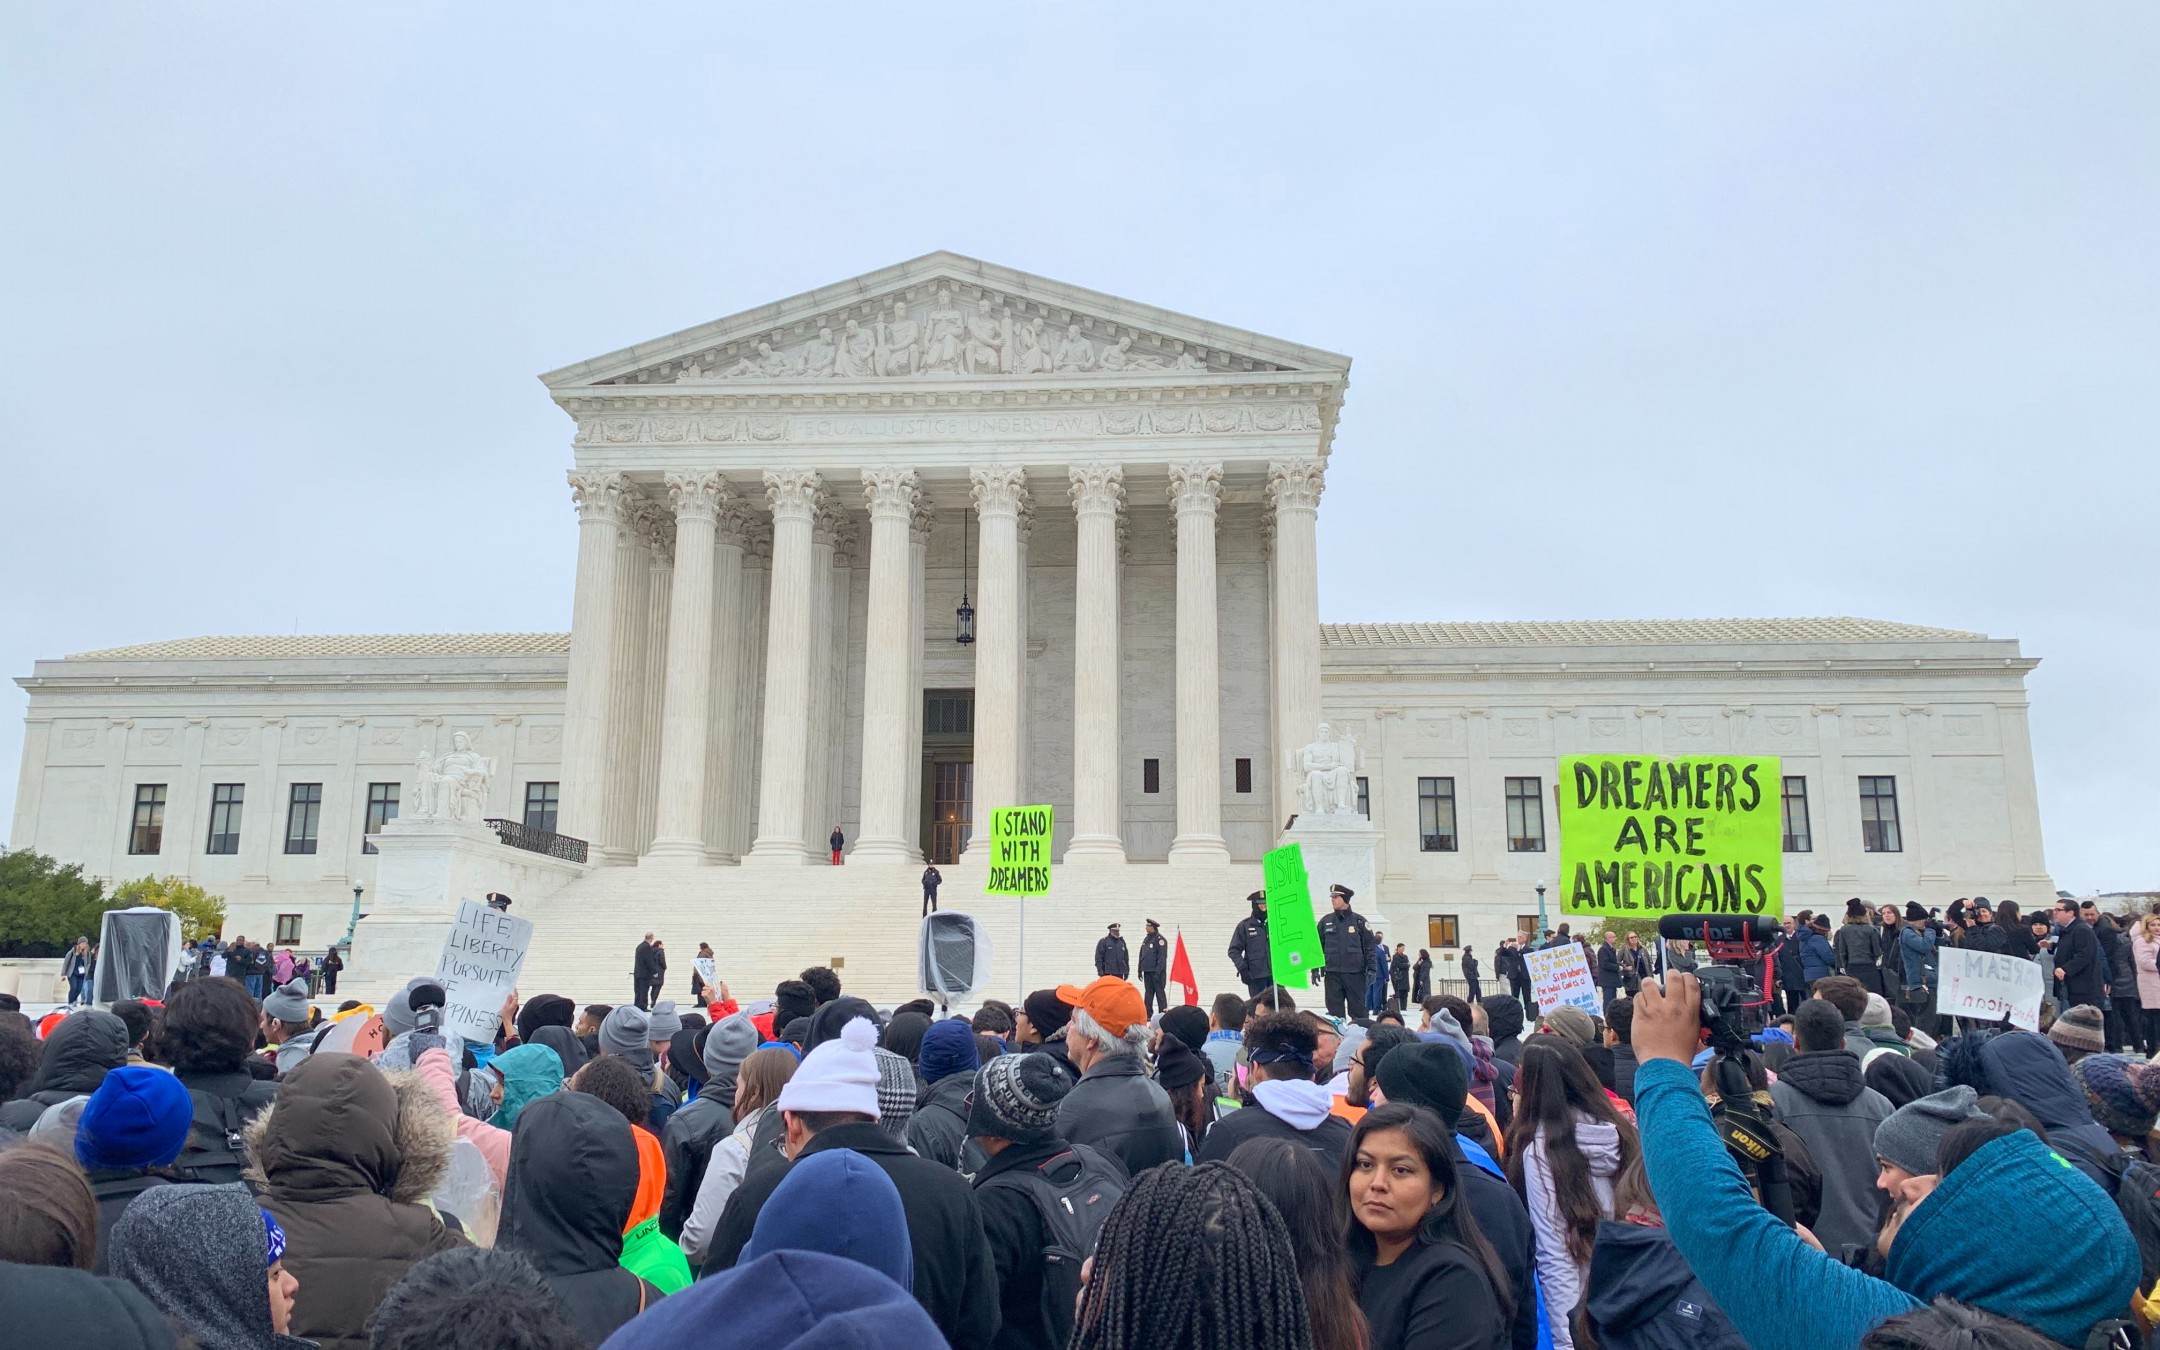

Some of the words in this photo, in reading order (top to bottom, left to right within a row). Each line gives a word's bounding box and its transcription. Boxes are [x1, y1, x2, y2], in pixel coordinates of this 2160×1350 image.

[804, 420, 873, 436] EQUAL
[876, 419, 958, 435] JUSTICE
[967, 417, 1035, 433] UNDER
[1043, 416, 1083, 432] LAW
[1573, 760, 1761, 814] DREAMERS
[995, 811, 999, 836] I
[1003, 811, 1047, 837] STAND
[1614, 815, 1707, 857] ARE
[1001, 840, 1040, 862] WITH
[988, 866, 1049, 893] DREAMERS
[1571, 860, 1767, 914] AMERICANS
[459, 901, 512, 939] LIFE,
[442, 952, 511, 987] PURSUIT
[444, 1001, 503, 1031] PPINESS
[1731, 1129, 1771, 1159] Nikon
[636, 1220, 659, 1240] UND
